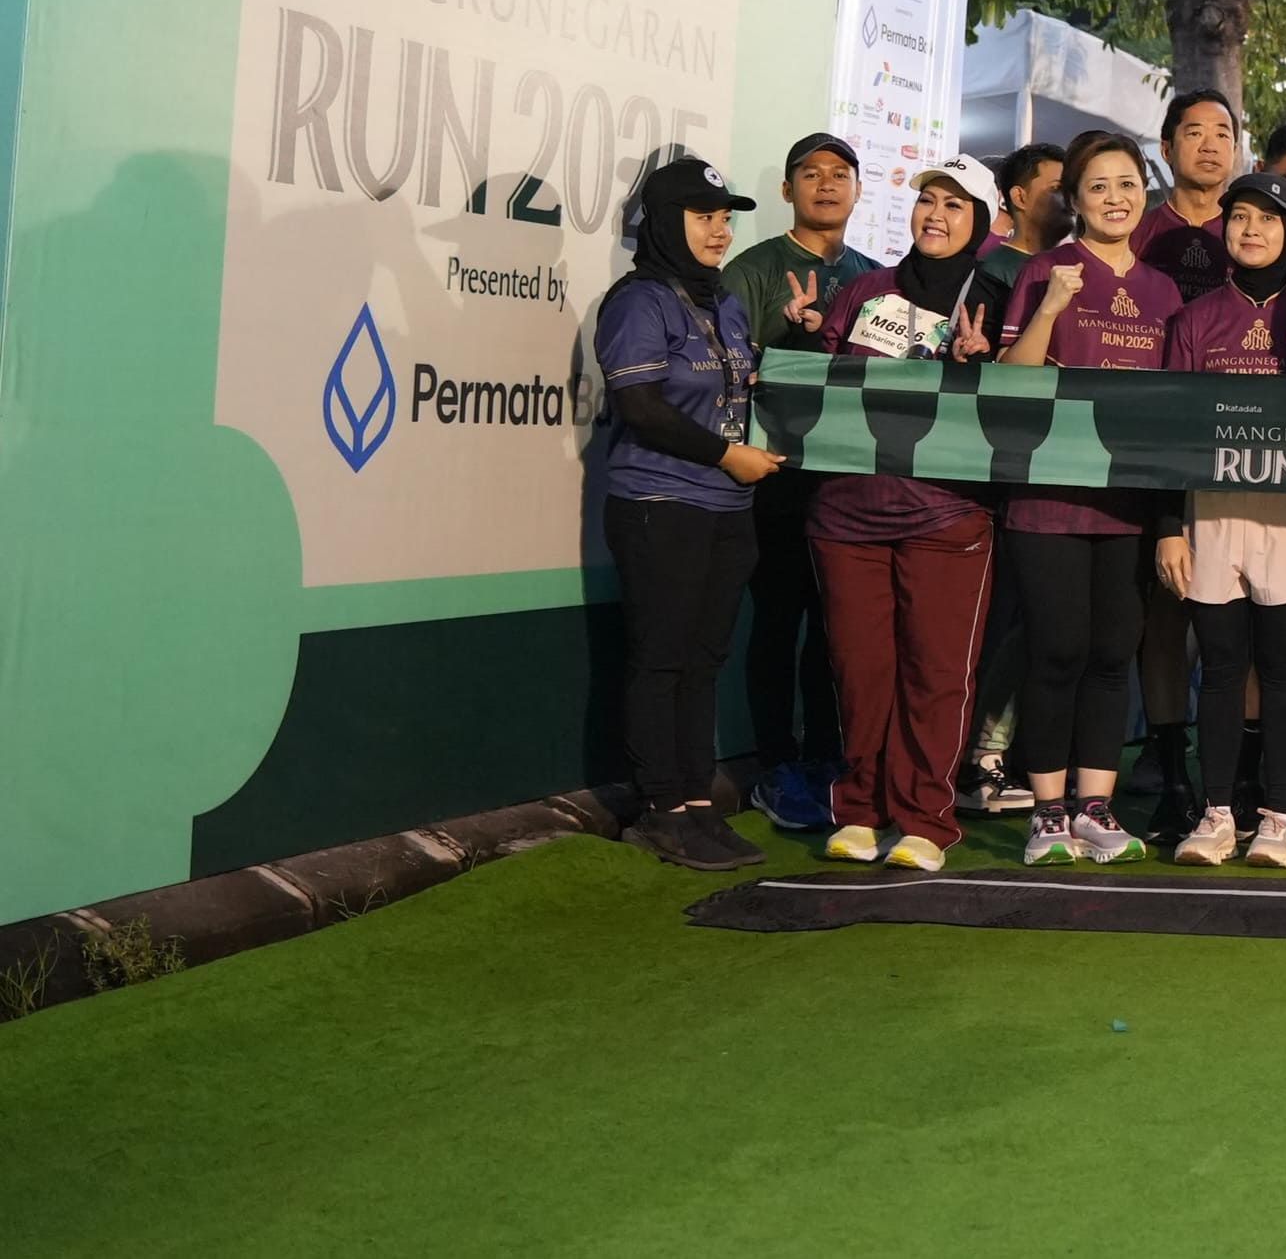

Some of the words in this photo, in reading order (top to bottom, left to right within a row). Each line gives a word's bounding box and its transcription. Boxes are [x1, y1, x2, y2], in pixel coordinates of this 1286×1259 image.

[881, 23, 917, 51] Permata
[267, 5, 500, 219] RUN
[944, 159, 967, 170] alo
[446, 257, 542, 304] Presented
[546, 264, 569, 311] by
[860, 330, 896, 349] Katharine
[1102, 332, 1124, 348] RUN
[1125, 335, 1155, 351] 2025
[410, 362, 563, 427] Permata
